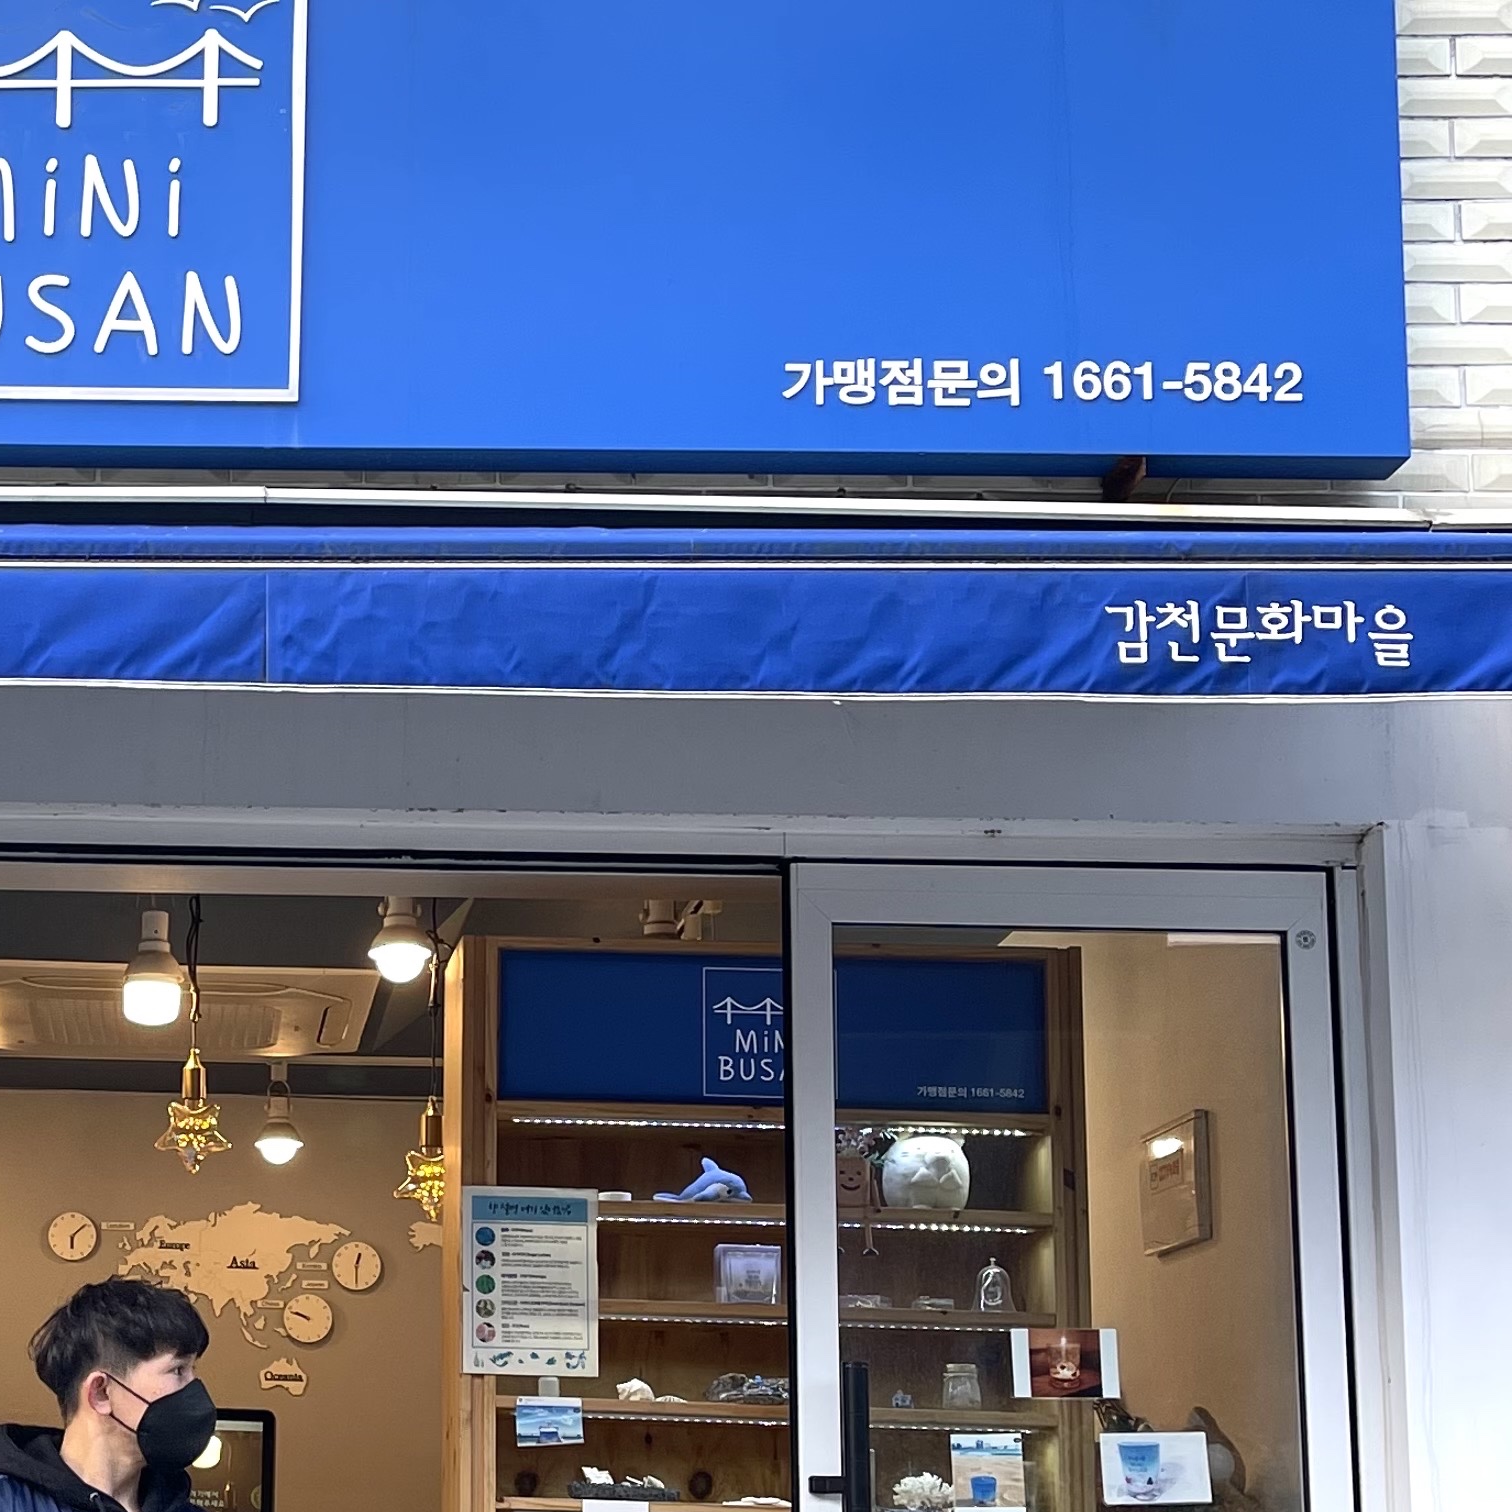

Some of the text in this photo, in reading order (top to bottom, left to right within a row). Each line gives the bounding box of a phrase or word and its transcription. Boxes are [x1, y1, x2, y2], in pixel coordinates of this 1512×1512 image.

[781, 358, 1304, 408] 가맹점문의 1661-5842
[717, 1055, 784, 1081] BUS
[158, 1239, 191, 1252] Europe
[227, 1255, 260, 1270] Asia
[264, 1370, 304, 1382] Oceania
